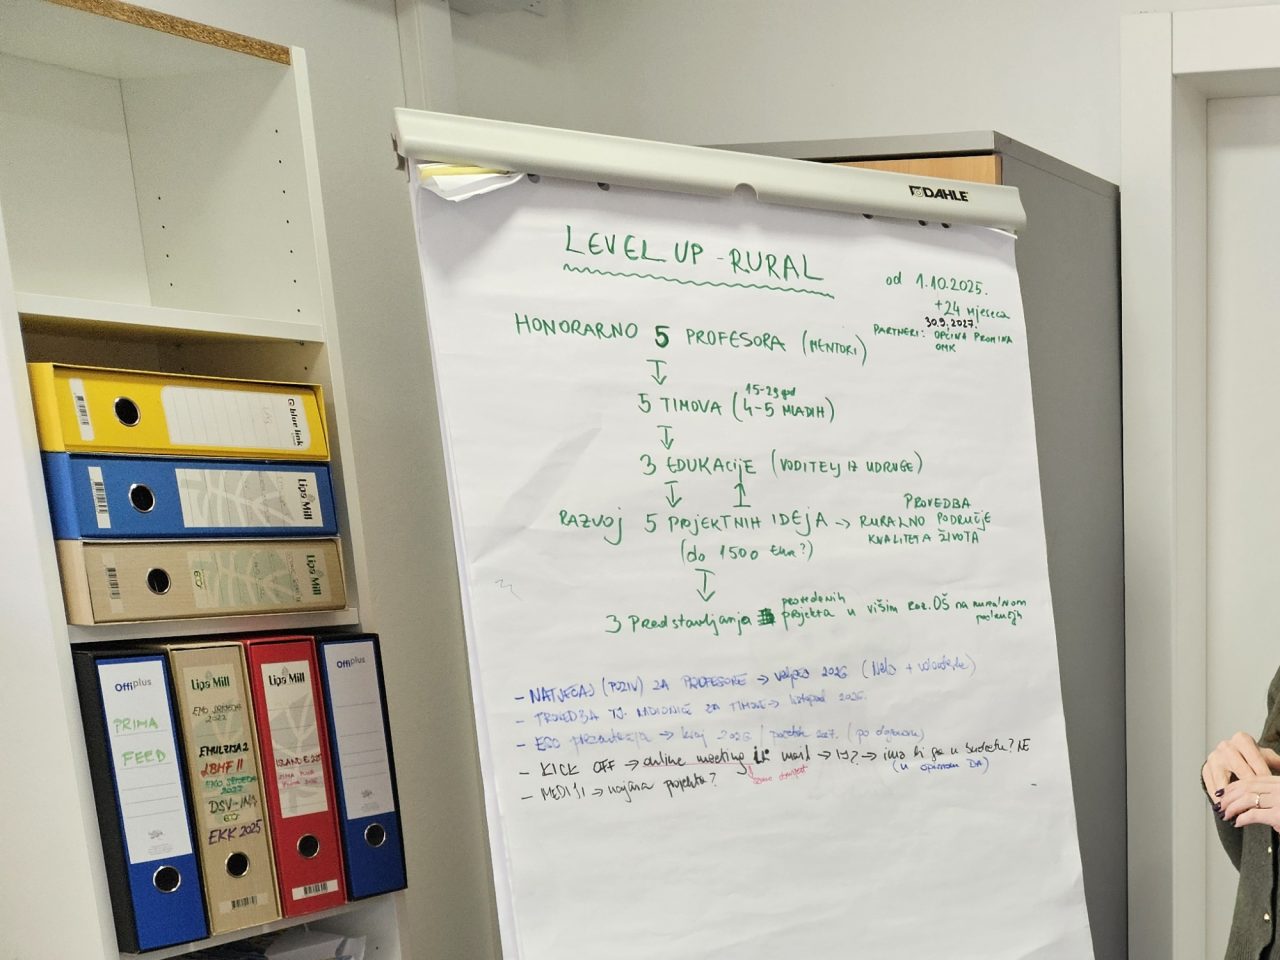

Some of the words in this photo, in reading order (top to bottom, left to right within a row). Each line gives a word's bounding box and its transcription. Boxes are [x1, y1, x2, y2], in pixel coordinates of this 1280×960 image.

[923, 187, 968, 202] DAHLE
[565, 225, 666, 262] LEVEL
[675, 240, 704, 264] UP
[729, 248, 824, 281] RURAL
[886, 272, 902, 285] od
[934, 299, 960, 317] +24
[515, 312, 638, 339] HONORARNO
[654, 325, 670, 348] 5
[686, 328, 786, 352] PROFESORA
[935, 343, 957, 352] OMK
[638, 393, 652, 413] 5
[659, 397, 723, 415] TIMOVA
[640, 454, 656, 476] 3
[903, 493, 972, 509] PROVEDBA
[301, 500, 314, 521] Mill
[643, 513, 659, 533] 5
[859, 514, 927, 530] RURALNO
[719, 544, 760, 561] 1500
[309, 575, 322, 597] Mill
[604, 614, 623, 634] 3
[954, 601, 969, 611] na
[212, 675, 231, 688] Mill
[288, 672, 306, 684] Mill
[113, 717, 160, 734] PRIMA
[121, 749, 167, 767] FEED
[541, 761, 580, 778] KICK
[592, 757, 617, 774] OFF
